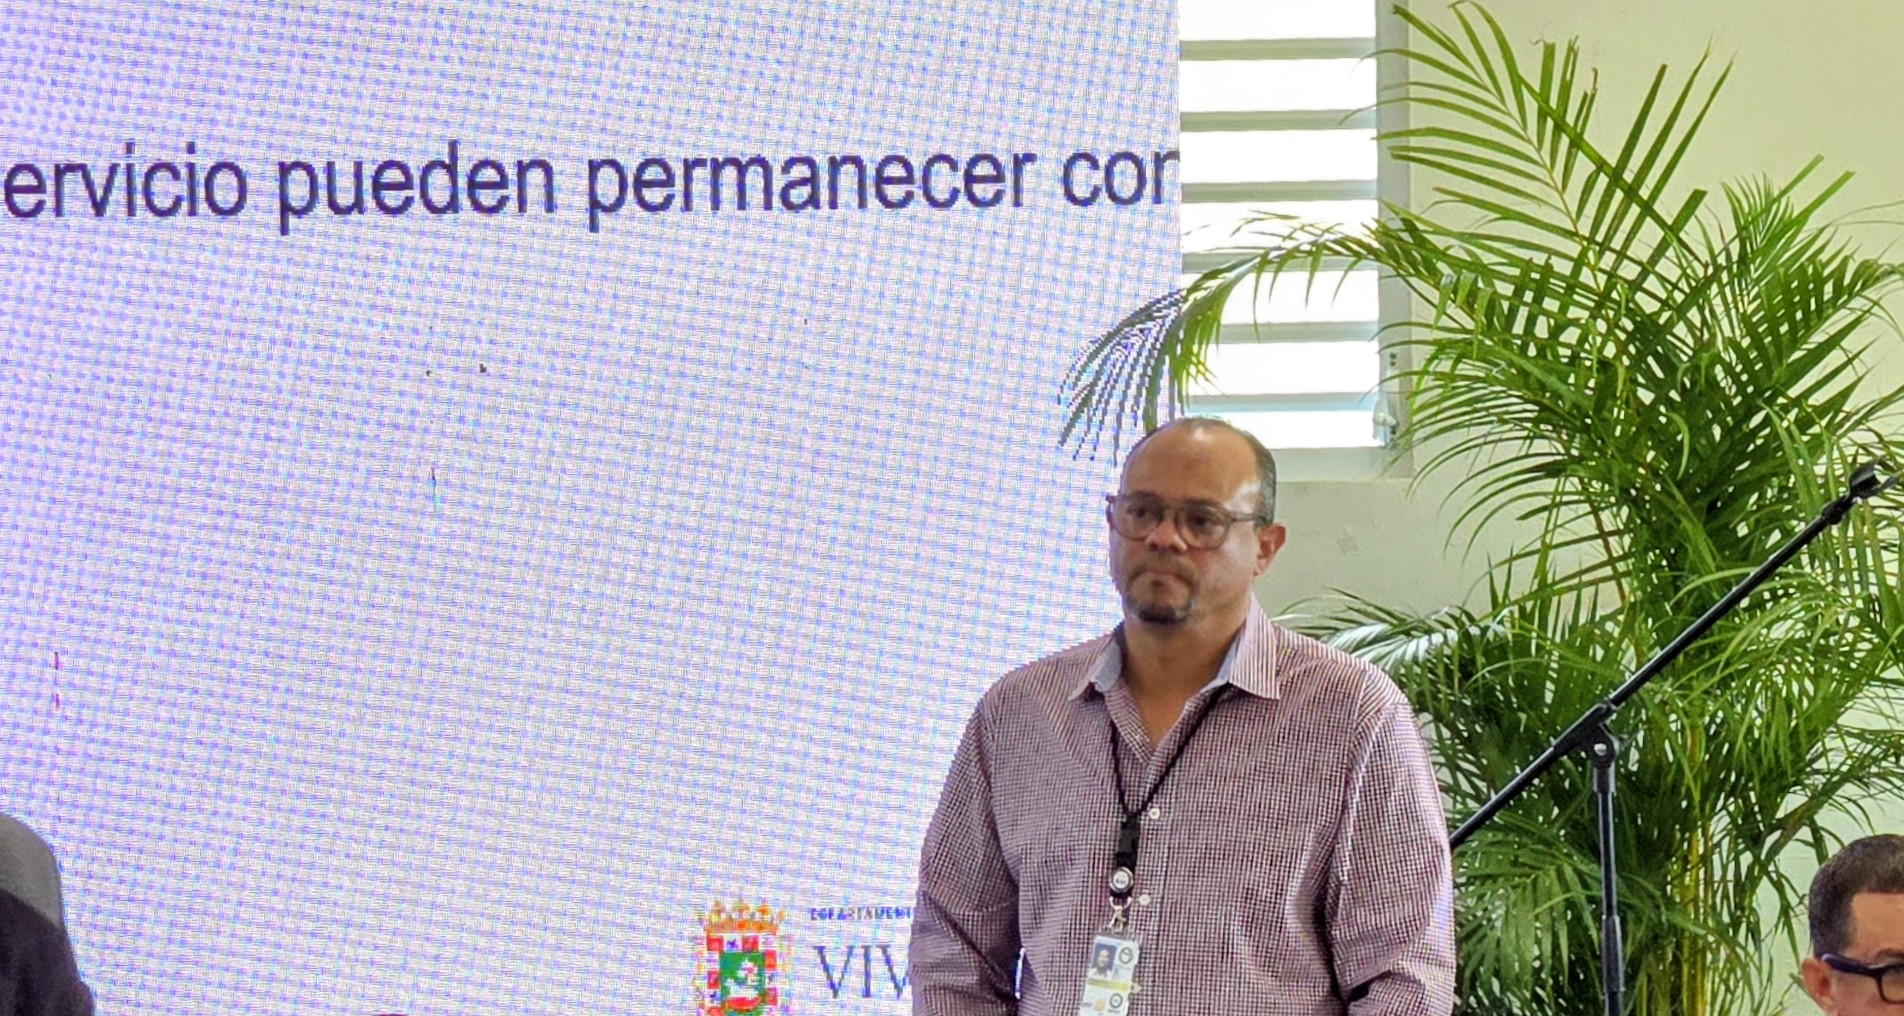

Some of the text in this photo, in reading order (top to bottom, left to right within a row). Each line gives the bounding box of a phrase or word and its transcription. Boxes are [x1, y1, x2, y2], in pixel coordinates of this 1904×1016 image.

[3, 140, 248, 218] ervicio
[278, 139, 556, 236] pueden
[586, 149, 1037, 233] permanecer
